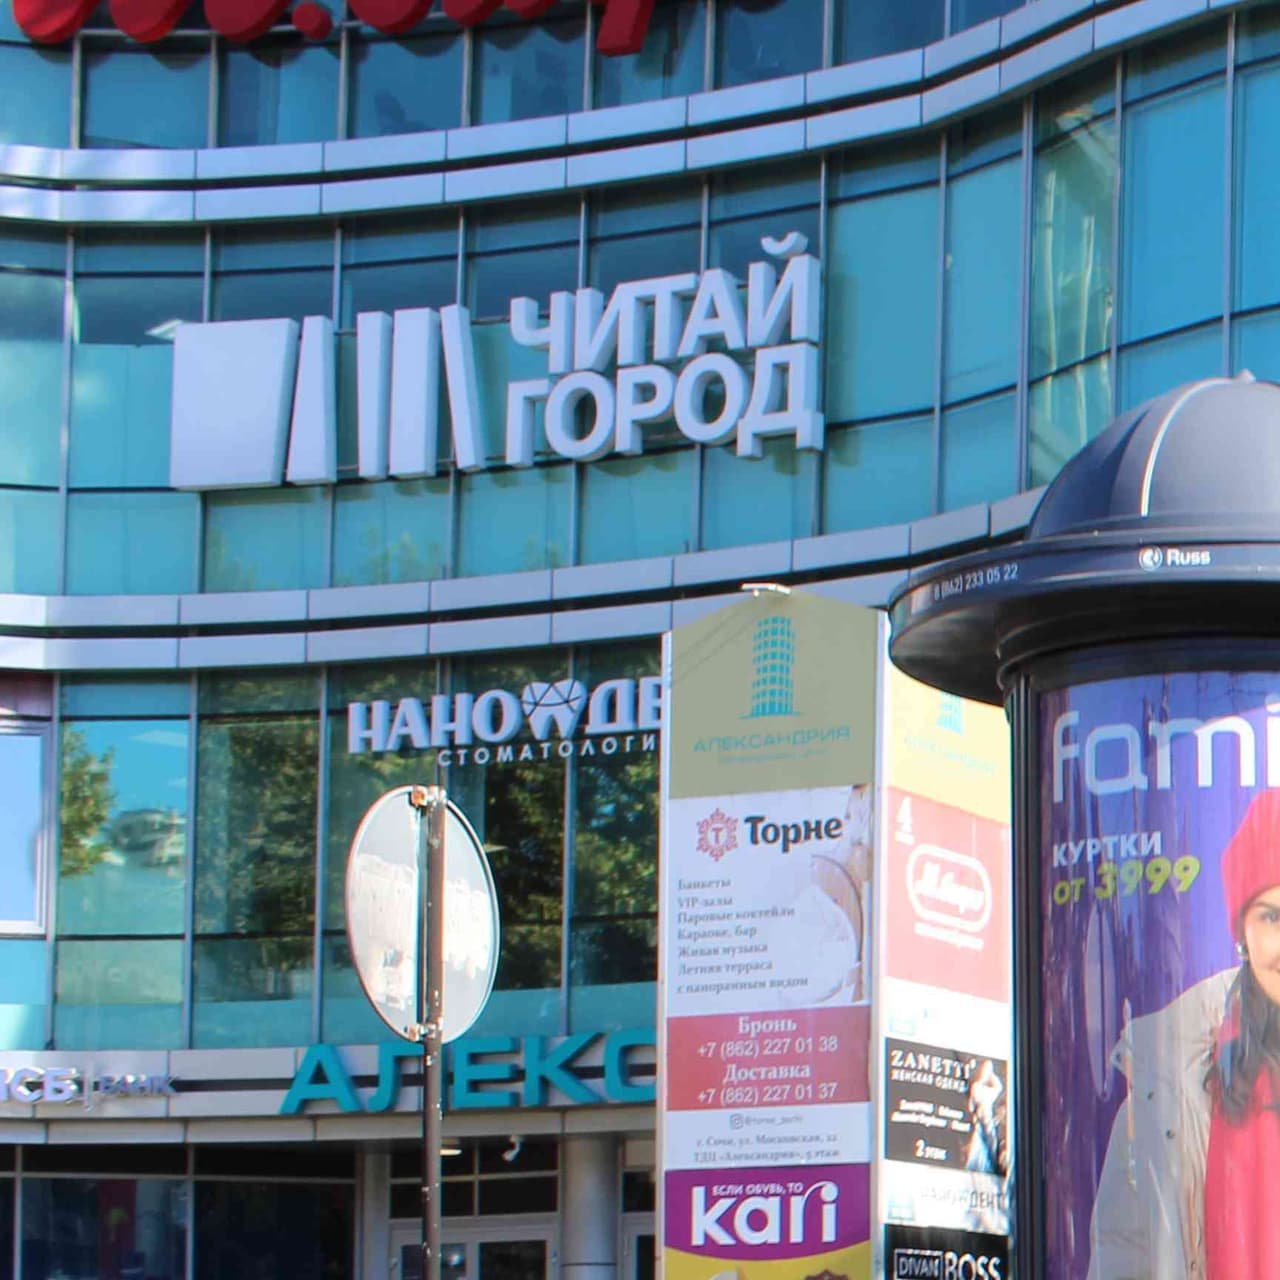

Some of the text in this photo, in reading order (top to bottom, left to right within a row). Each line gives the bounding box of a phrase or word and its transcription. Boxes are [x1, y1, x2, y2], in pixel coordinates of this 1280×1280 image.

[510, 231, 821, 373] ЧИТАЙ
[505, 341, 824, 467] ГОРОД
[1166, 549, 1211, 566] Russ
[965, 571, 984, 590] 233
[987, 567, 1000, 583] 05
[1003, 563, 1019, 580] 22
[348, 676, 662, 753] НАНО ДЕ
[437, 735, 657, 767] СТОМАТОЛОГИ
[693, 726, 853, 753] АЛЕКСАНДРИЯ
[744, 815, 843, 853] Торне
[1053, 832, 1161, 868] КУРТКИ
[678, 878, 731, 891] Банкеты
[1095, 855, 1201, 899] 3999
[737, 905, 795, 921] коктейли
[735, 924, 757, 938] бар
[725, 960, 773, 974] терраса
[738, 1016, 797, 1038] Бронь
[698, 1035, 838, 1061] +7 (862) 227 01 38
[279, 1027, 656, 1115] АЛЕКС
[722, 1063, 811, 1085] Доставка
[698, 1082, 838, 1106] +7 (862) 227 01 37
[712, 1185, 743, 1196] ЕСЛИ
[787, 1182, 803, 1193] ТО
[691, 1181, 838, 1246] kari
[899, 1257, 940, 1277] DIVAN
